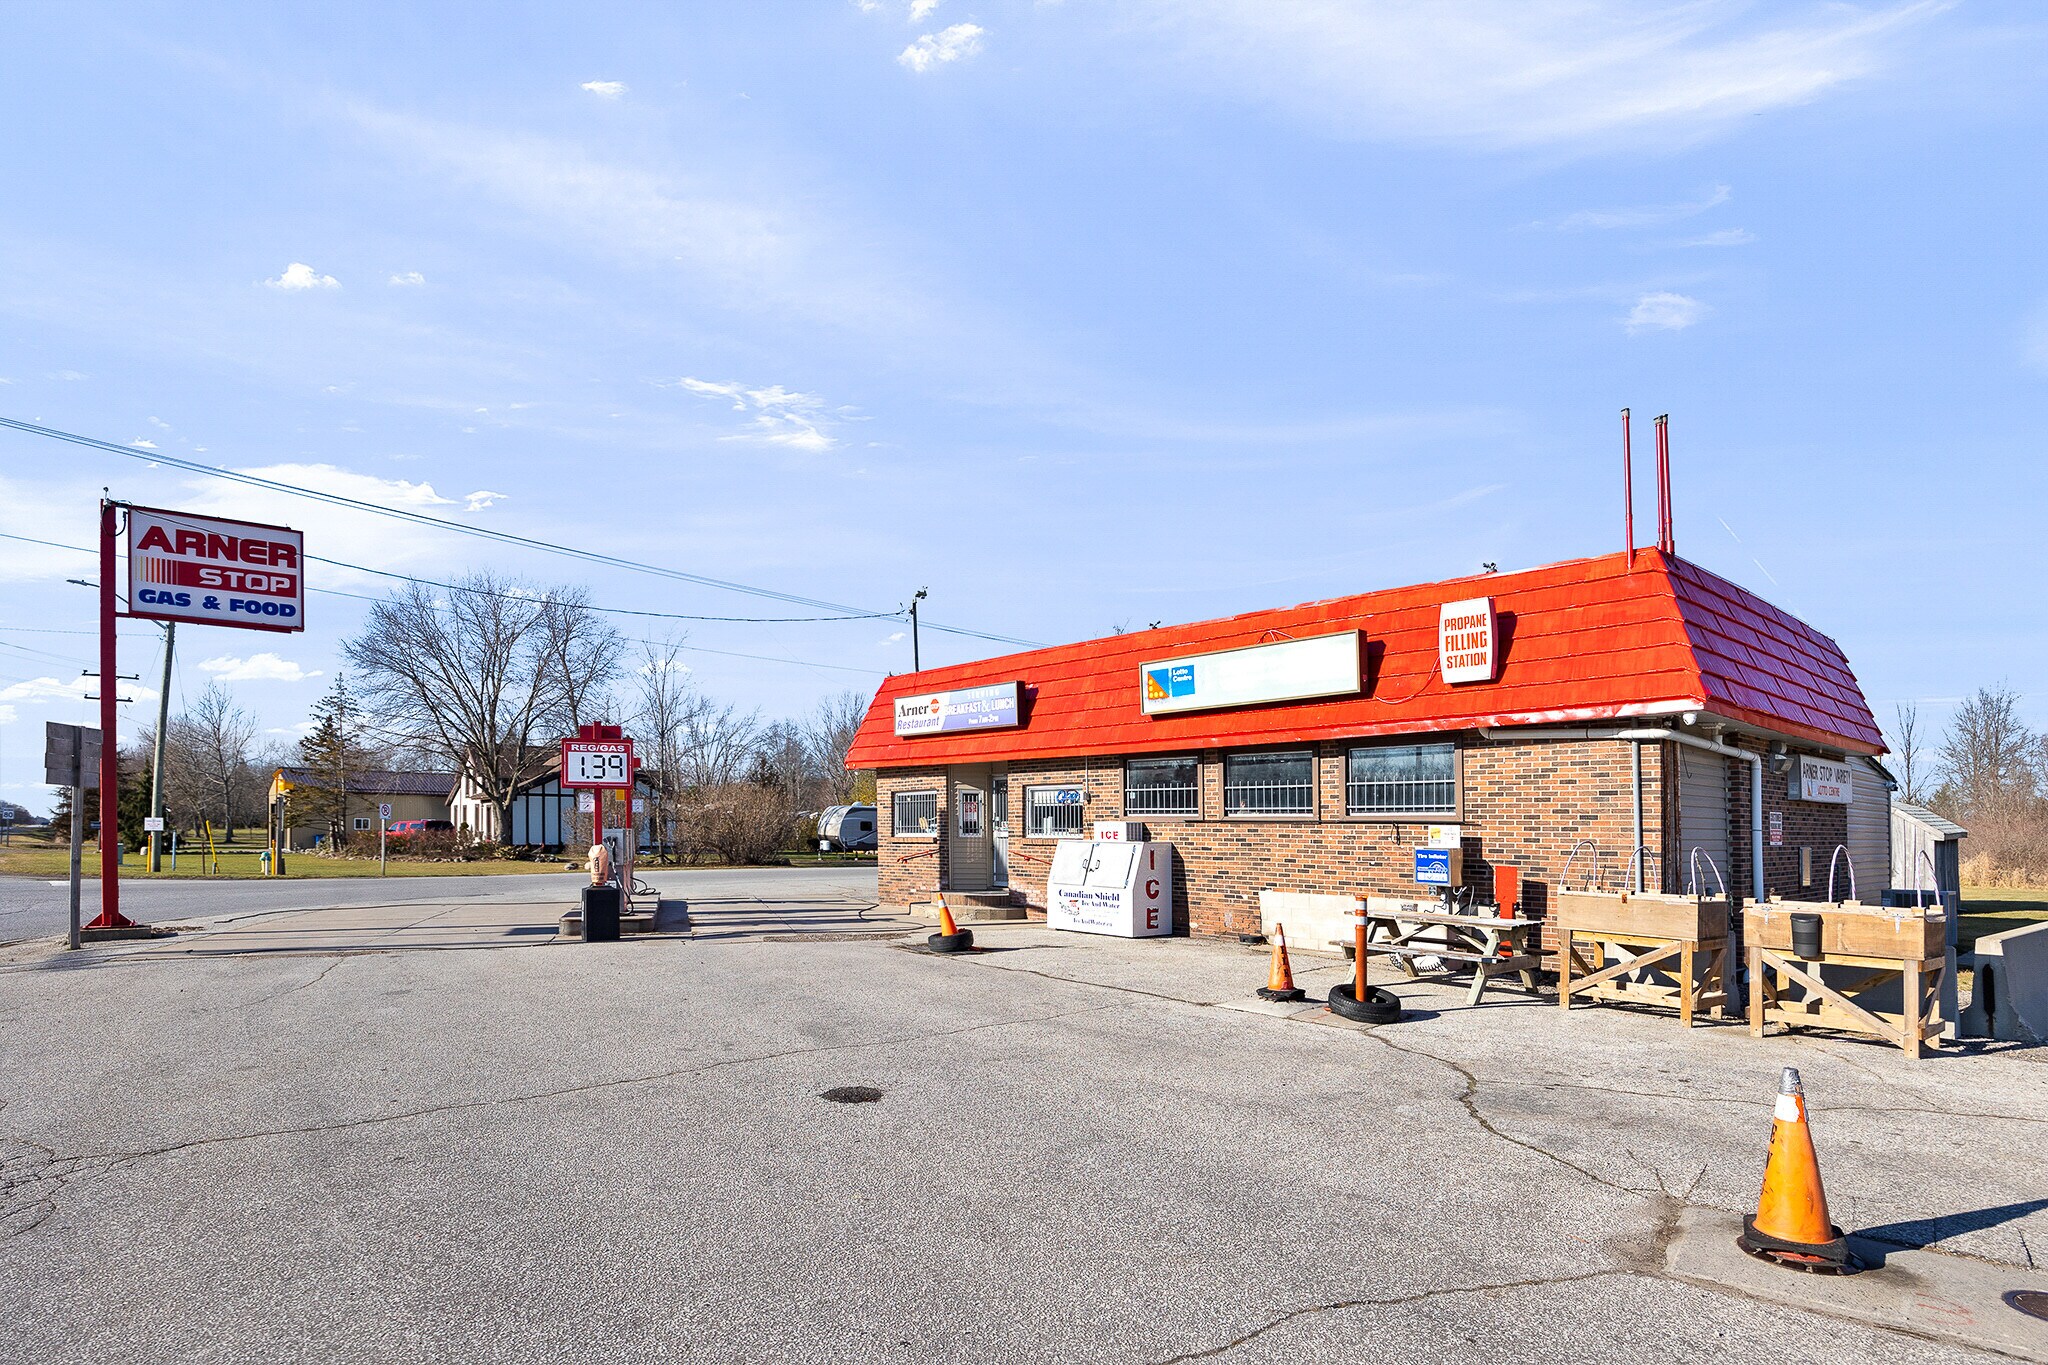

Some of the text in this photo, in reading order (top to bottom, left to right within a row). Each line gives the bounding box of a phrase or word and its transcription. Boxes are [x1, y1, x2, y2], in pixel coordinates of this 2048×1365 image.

[137, 525, 297, 569] ARNER
[199, 568, 291, 593] STOP
[138, 588, 296, 618] GAS & FOOD
[1444, 613, 1487, 631] PROPANE
[1445, 630, 1488, 652] FILLING
[1446, 651, 1487, 669] STATION
[1172, 668, 1189, 676] Lotto
[1172, 675, 1193, 683] Centre
[967, 688, 1000, 700] SERVING
[898, 704, 929, 718] Arner
[944, 696, 1015, 716] BREAKFAST & LUNCH
[897, 716, 940, 730] Restaurant
[571, 744, 625, 752] REG/GAS
[581, 754, 623, 779] 1.39
[1802, 763, 1851, 785] ARNER STOP VARIETY
[1100, 831, 1119, 840] ICE
[1058, 889, 1120, 901] Canadian Shield
[1145, 849, 1160, 930] ICE
[1102, 901, 1120, 909] Water
